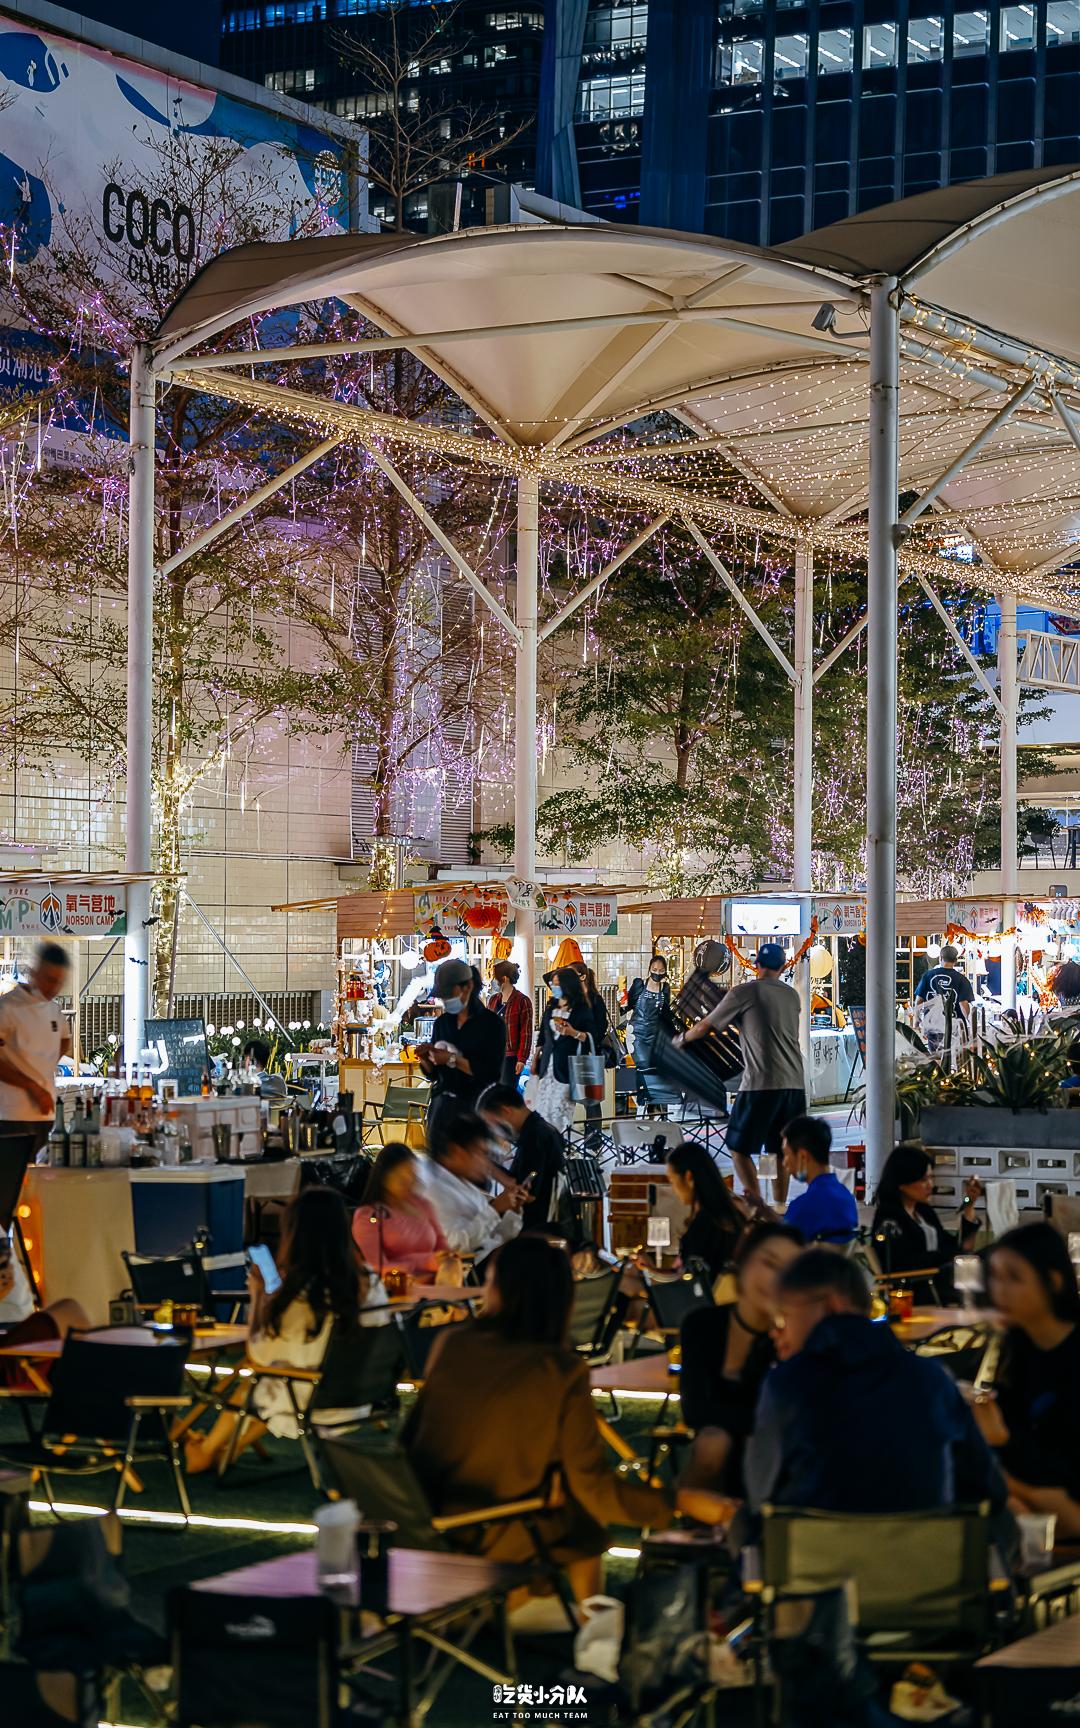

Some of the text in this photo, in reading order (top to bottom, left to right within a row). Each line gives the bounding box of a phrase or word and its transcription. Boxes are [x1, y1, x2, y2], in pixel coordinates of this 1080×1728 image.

[103, 183, 195, 263] COCO
[66, 894, 116, 913] 氧气营地
[579, 902, 611, 917] 氧气营地
[65, 915, 115, 926] NORSON CAMP
[579, 918, 598, 928] NORSON
